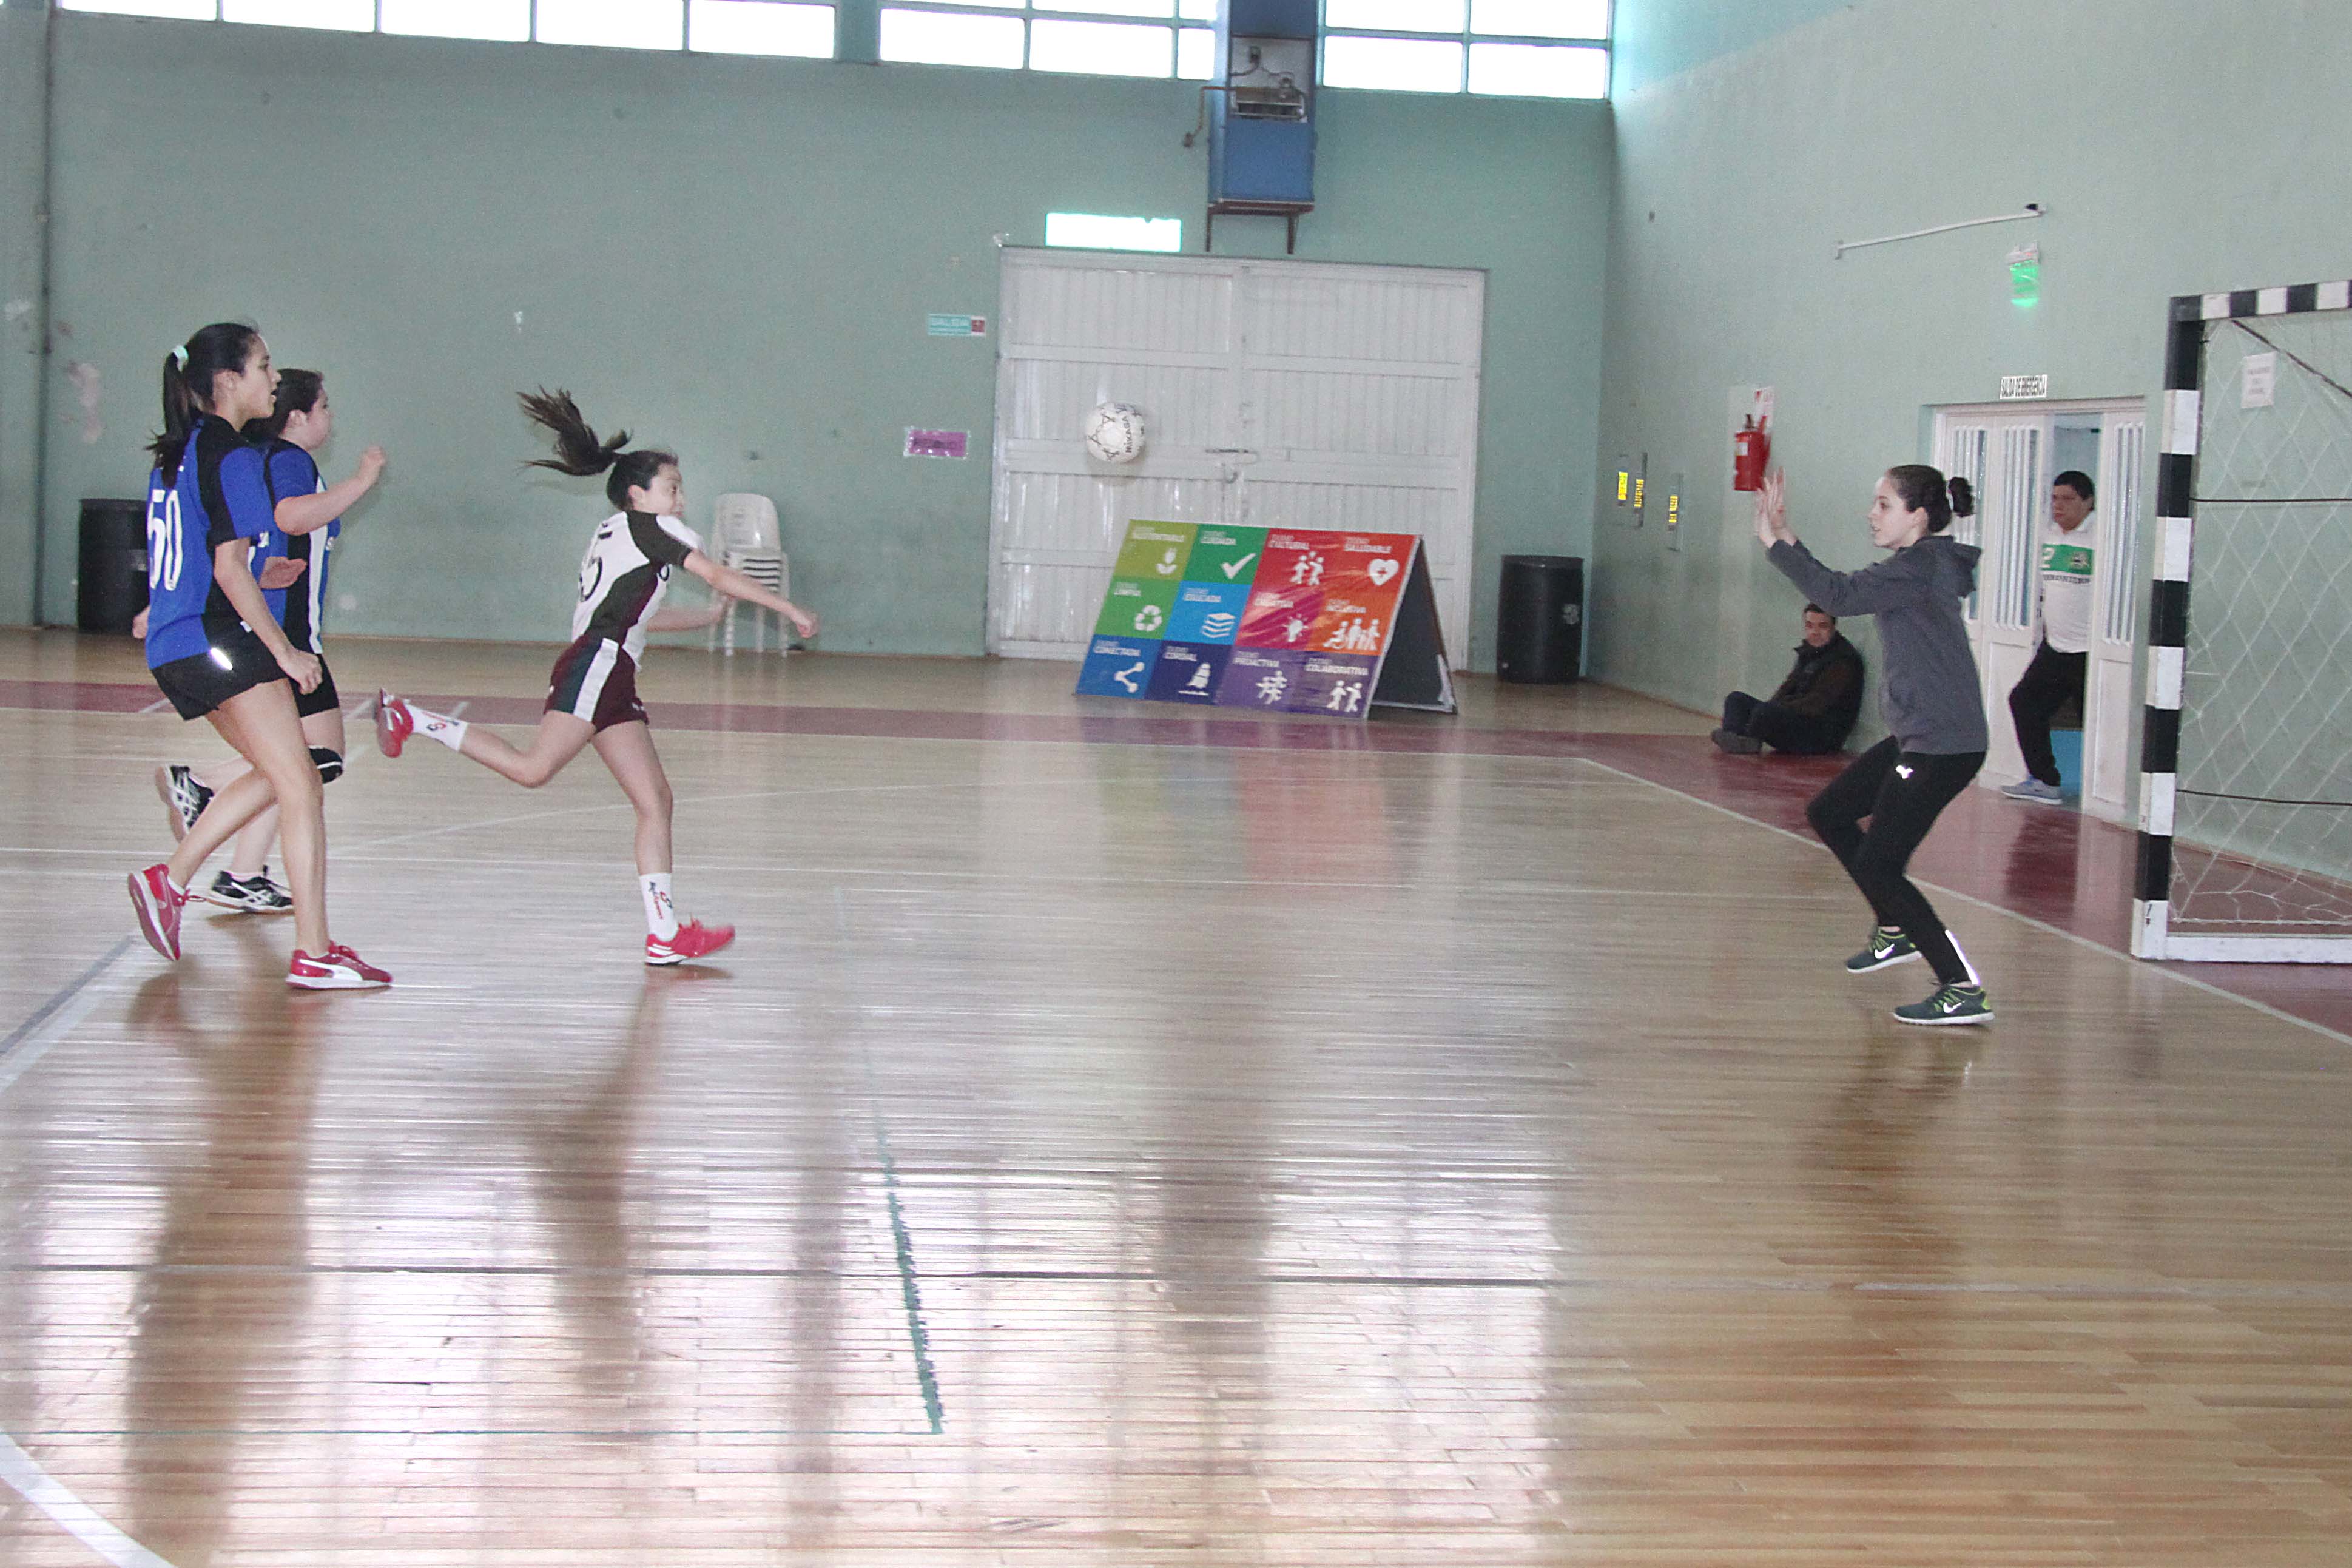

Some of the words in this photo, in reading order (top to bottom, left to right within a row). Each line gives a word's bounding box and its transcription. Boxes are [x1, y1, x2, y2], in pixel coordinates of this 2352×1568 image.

[147, 489, 183, 590] 50
[1268, 540, 1310, 550] CULTURAL
[1344, 543, 1392, 553] SALUDABLE
[1233, 657, 1279, 667] PROACTIVA
[1304, 664, 1369, 675] COLABORATIVA
